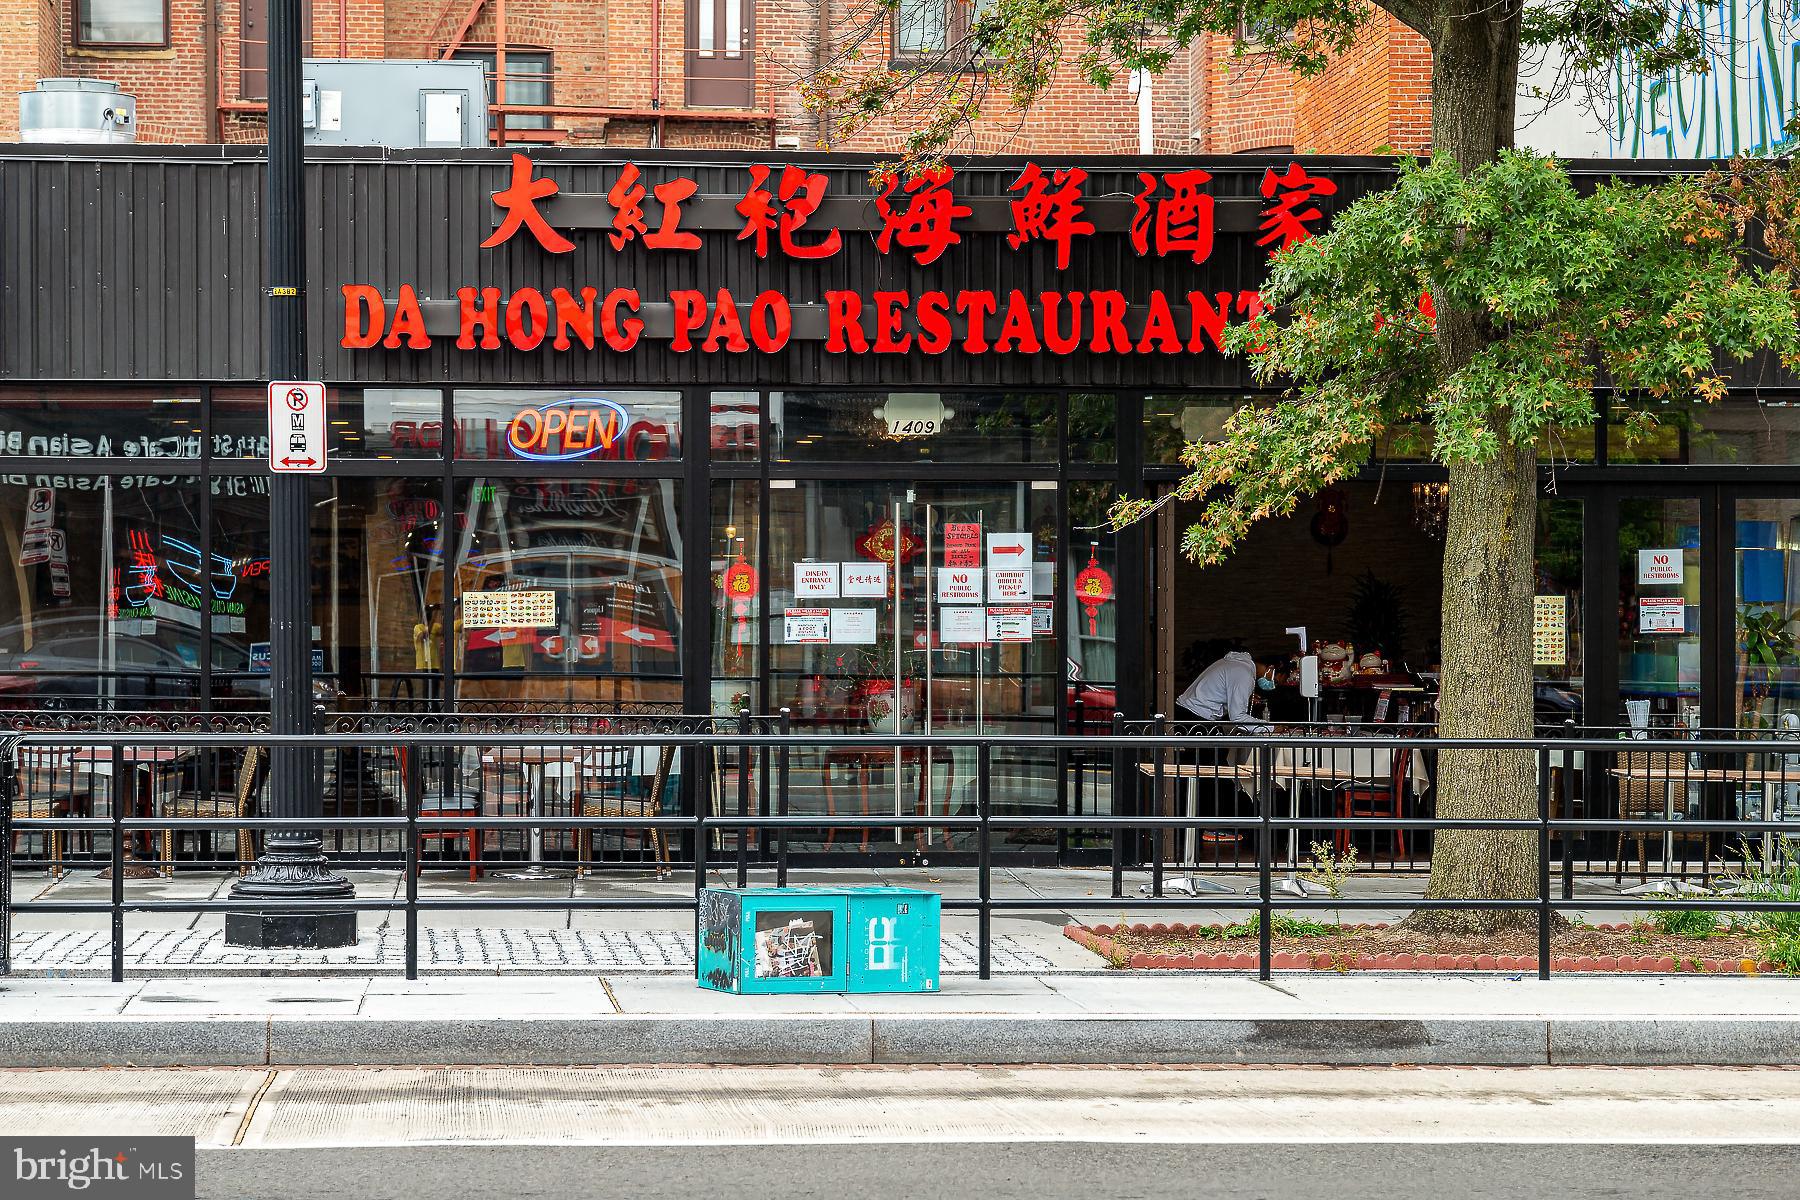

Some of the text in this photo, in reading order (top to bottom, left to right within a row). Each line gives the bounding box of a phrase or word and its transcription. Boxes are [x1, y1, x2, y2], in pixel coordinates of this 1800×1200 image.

[340, 284, 432, 350] DA
[456, 287, 645, 352] HONG
[669, 288, 792, 354] PAO
[824, 290, 1275, 356] RESTAURANT
[511, 408, 618, 450] OPEN
[893, 420, 935, 434] 1409
[473, 486, 497, 502] EXIT
[1653, 555, 1669, 565] NO
[952, 574, 969, 584] NO
